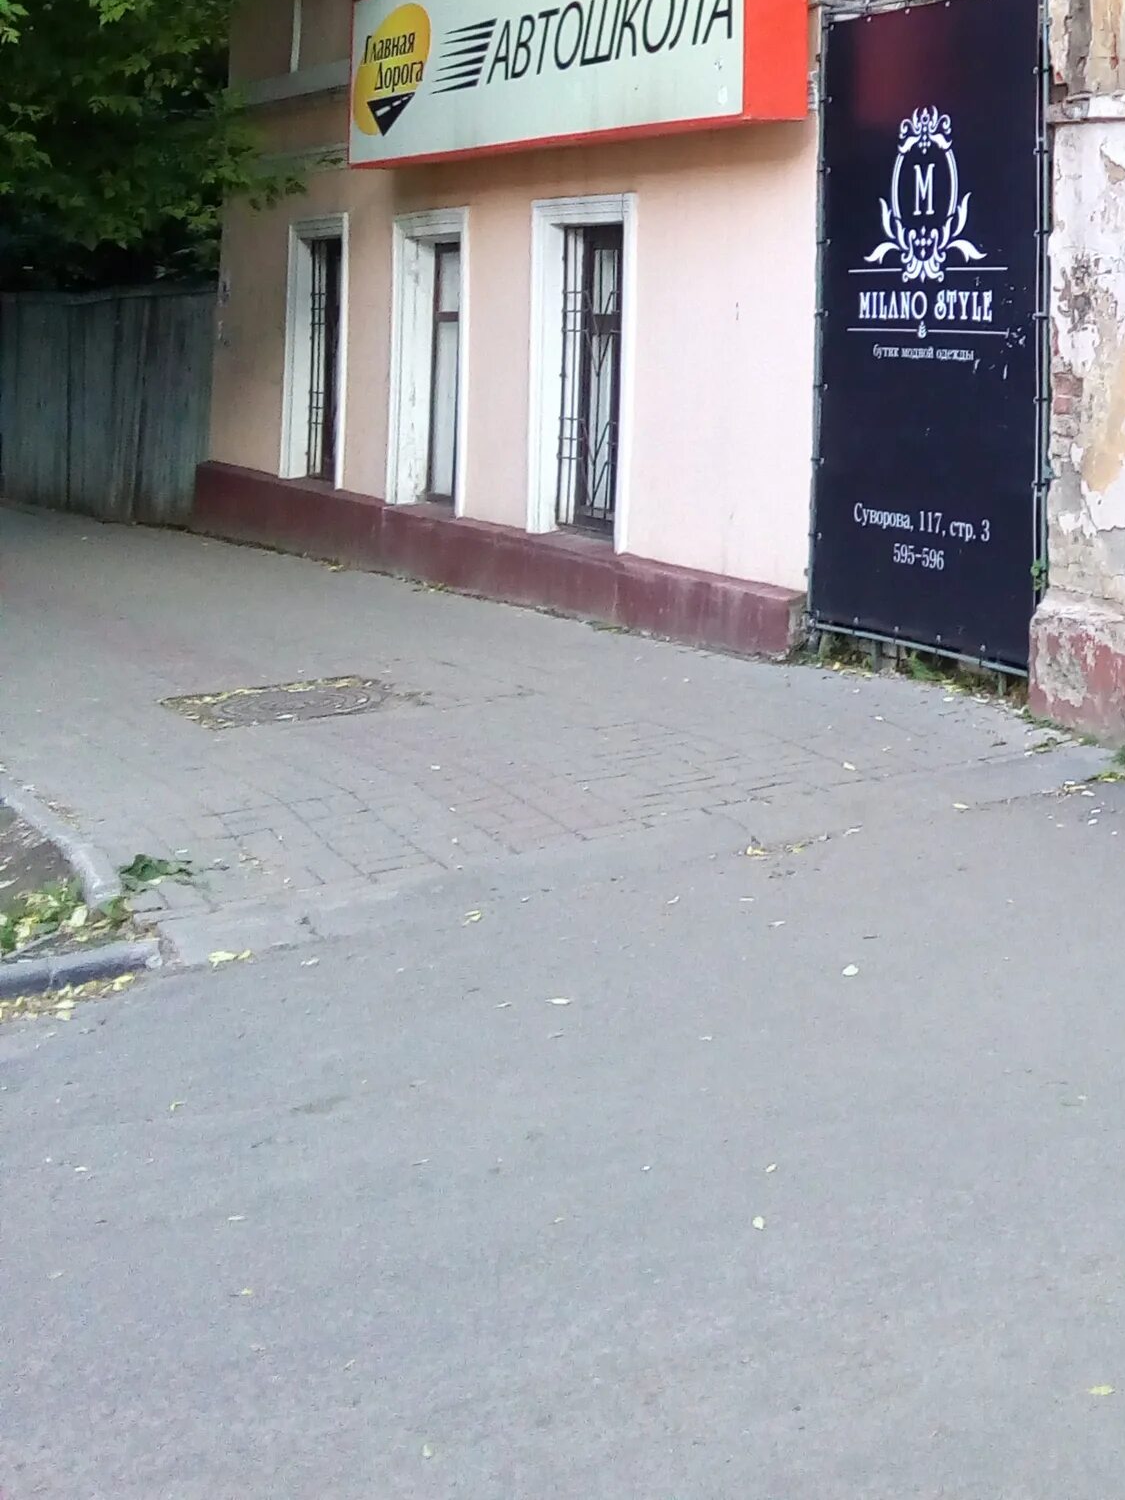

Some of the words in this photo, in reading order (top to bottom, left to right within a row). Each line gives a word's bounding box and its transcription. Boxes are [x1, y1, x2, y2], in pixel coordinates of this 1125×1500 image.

[364, 32, 416, 64] Главная
[374, 61, 424, 93] Дорога
[913, 163, 936, 216] M
[858, 290, 929, 320] MILANO
[934, 289, 993, 322] STYLE
[873, 343, 899, 359] бутик
[901, 346, 934, 359] модной
[936, 348, 974, 360] одежды
[853, 503, 914, 531] Суворова,
[919, 511, 946, 537] 117,
[949, 521, 977, 542] стр.
[981, 519, 991, 542] 3
[893, 542, 945, 571] 595-596
